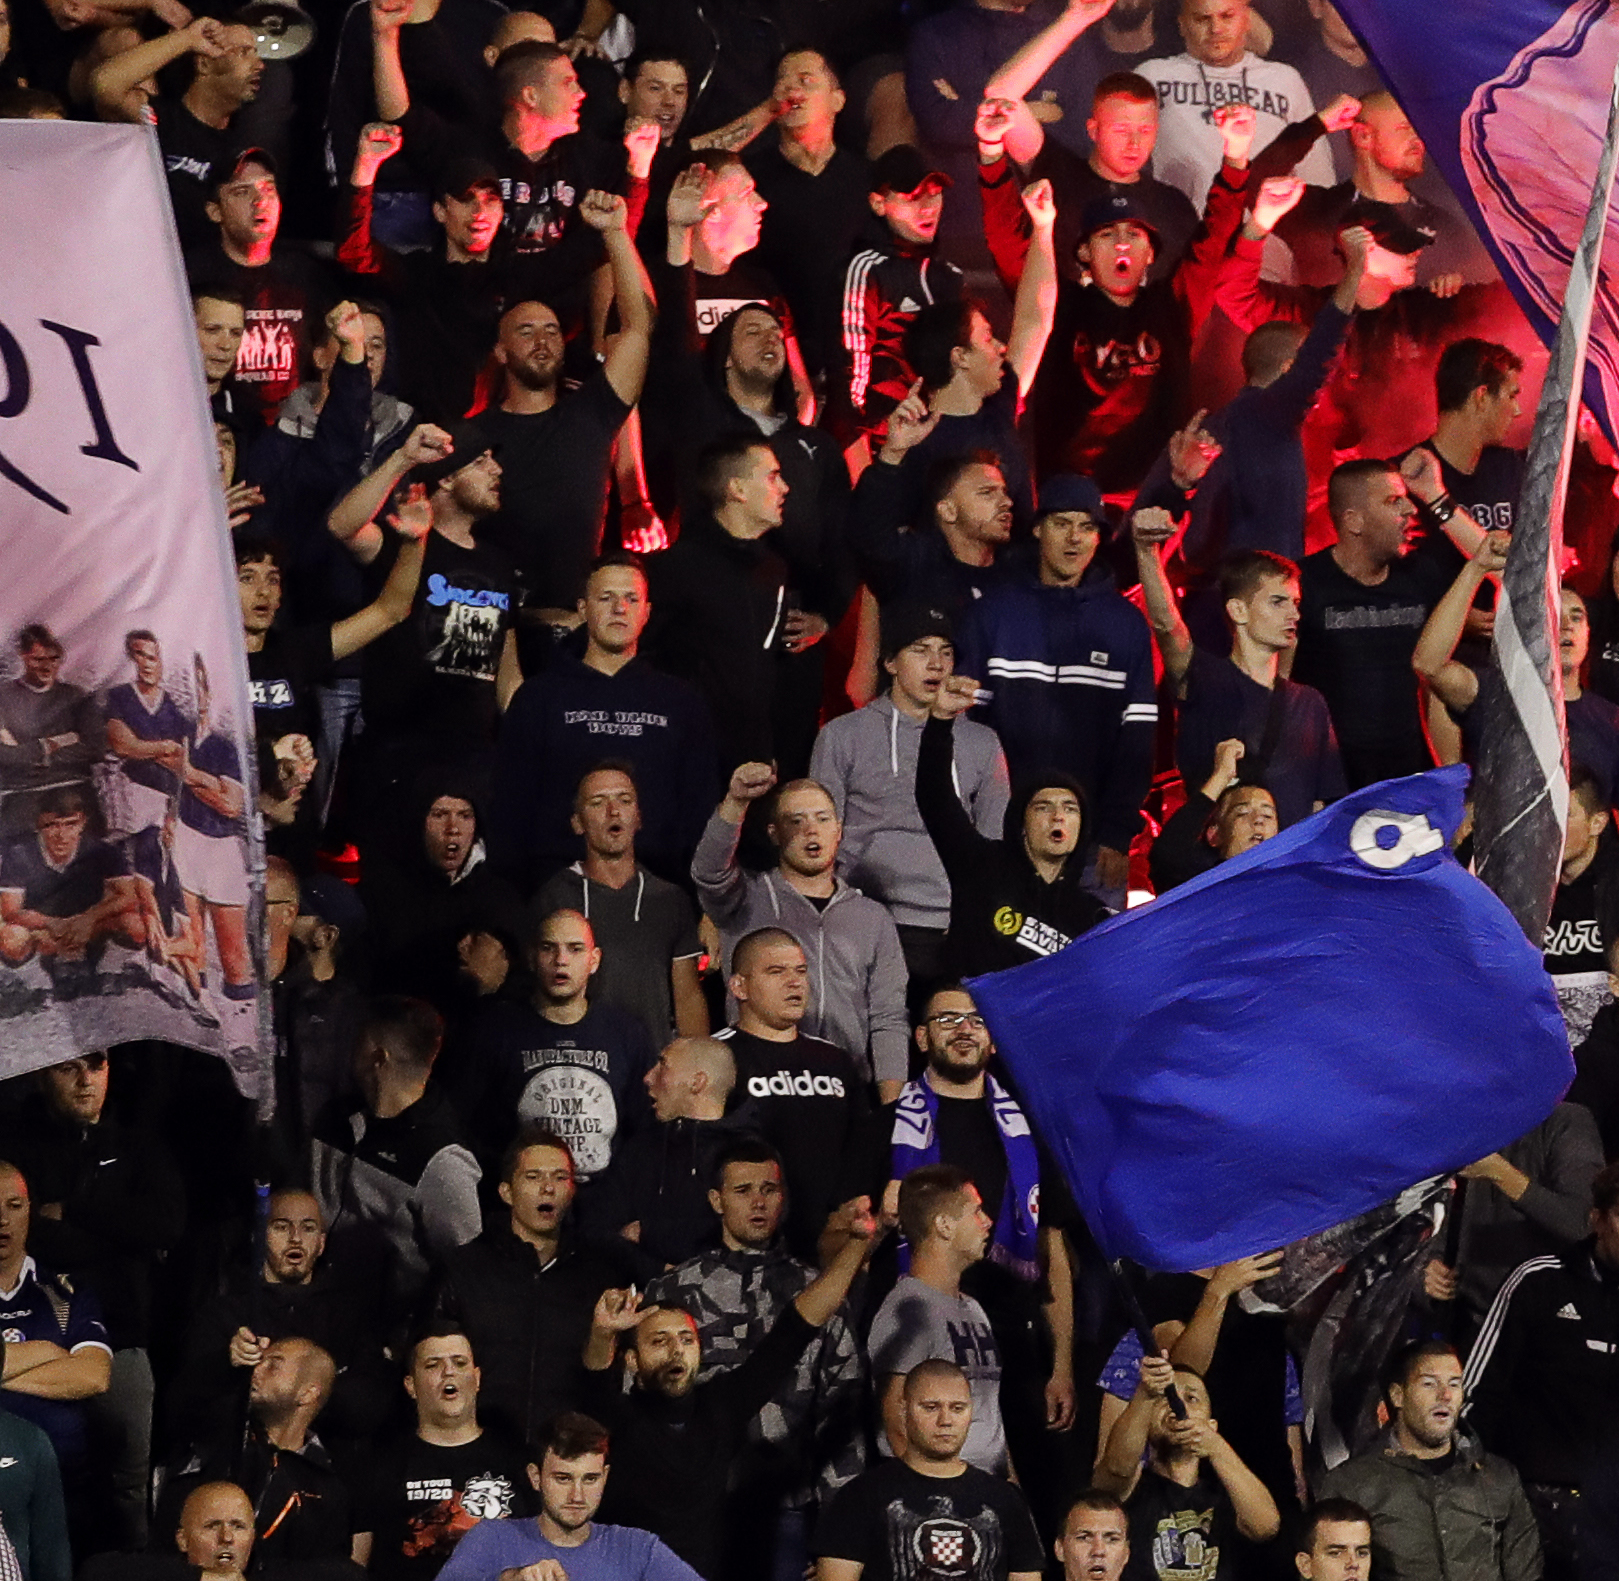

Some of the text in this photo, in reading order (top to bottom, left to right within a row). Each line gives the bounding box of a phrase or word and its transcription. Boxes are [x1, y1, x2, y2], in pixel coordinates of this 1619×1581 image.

[533, 1075, 603, 1104] ORIGINAL
[747, 1069, 846, 1098] adidas
[406, 1487, 454, 1501] 19/20
